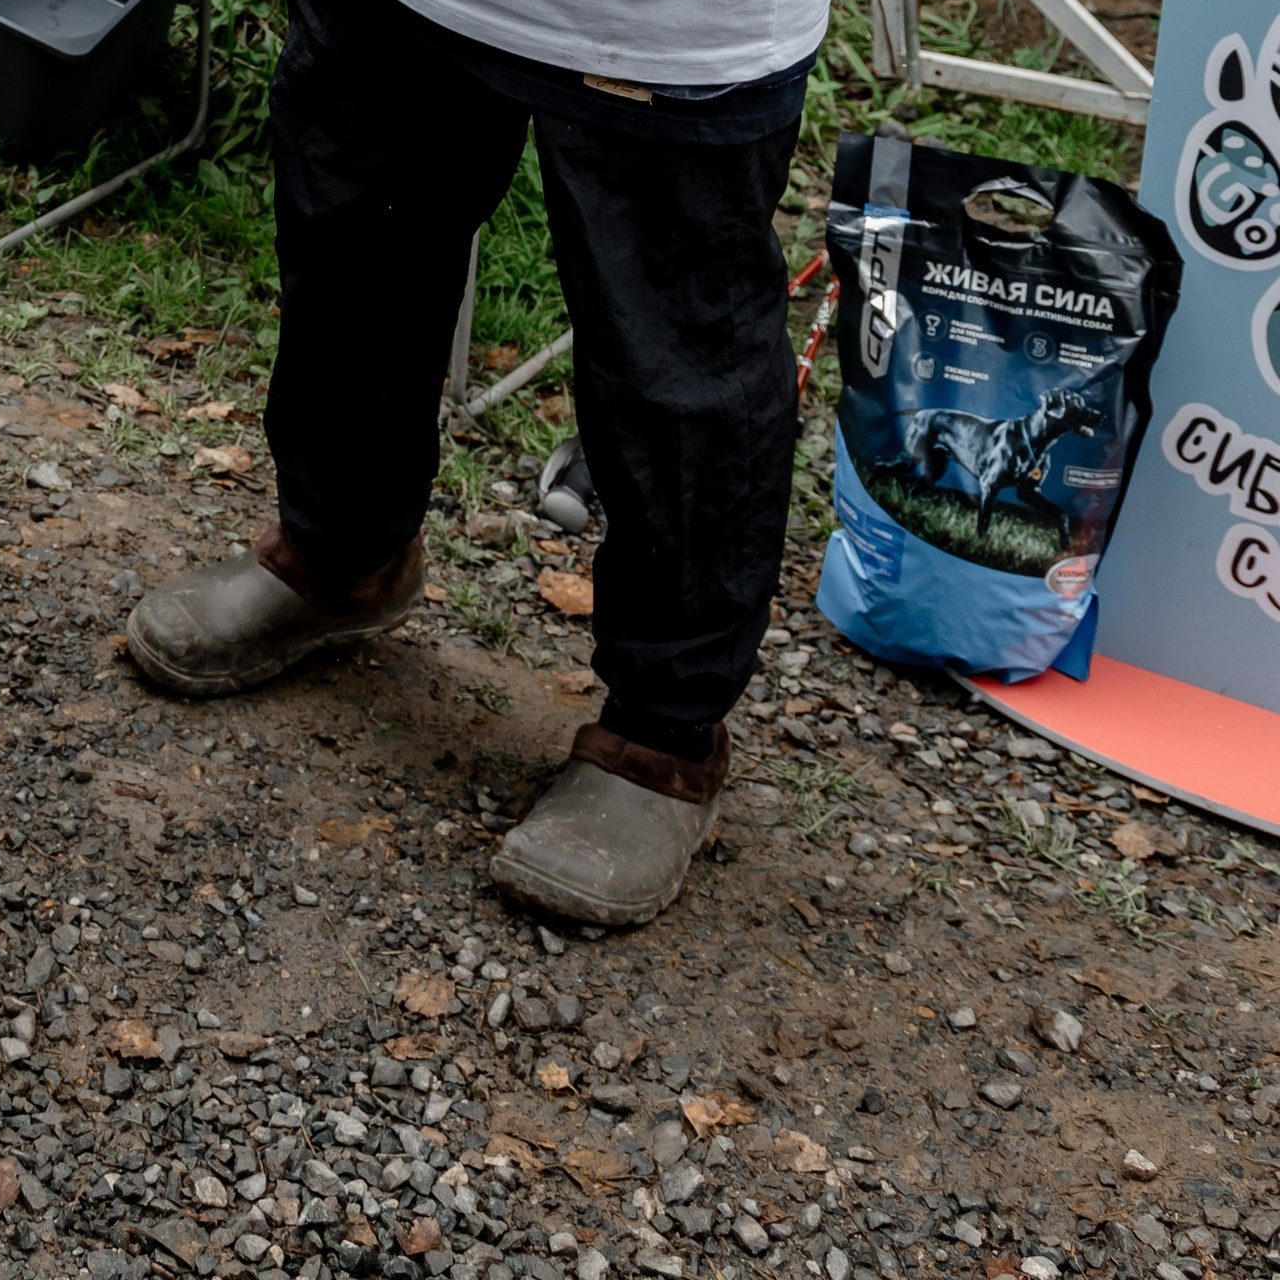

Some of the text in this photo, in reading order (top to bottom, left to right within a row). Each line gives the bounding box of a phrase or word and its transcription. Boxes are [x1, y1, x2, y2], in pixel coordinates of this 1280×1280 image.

[922, 285, 949, 299] КОРМ
[966, 294, 1025, 316] СПОРТИВНЫХ
[1033, 308, 1083, 327] АКТИВНЫХ
[1083, 319, 1115, 332] СОБАК
[923, 260, 1115, 320] ЖИВАЯ СИЛА
